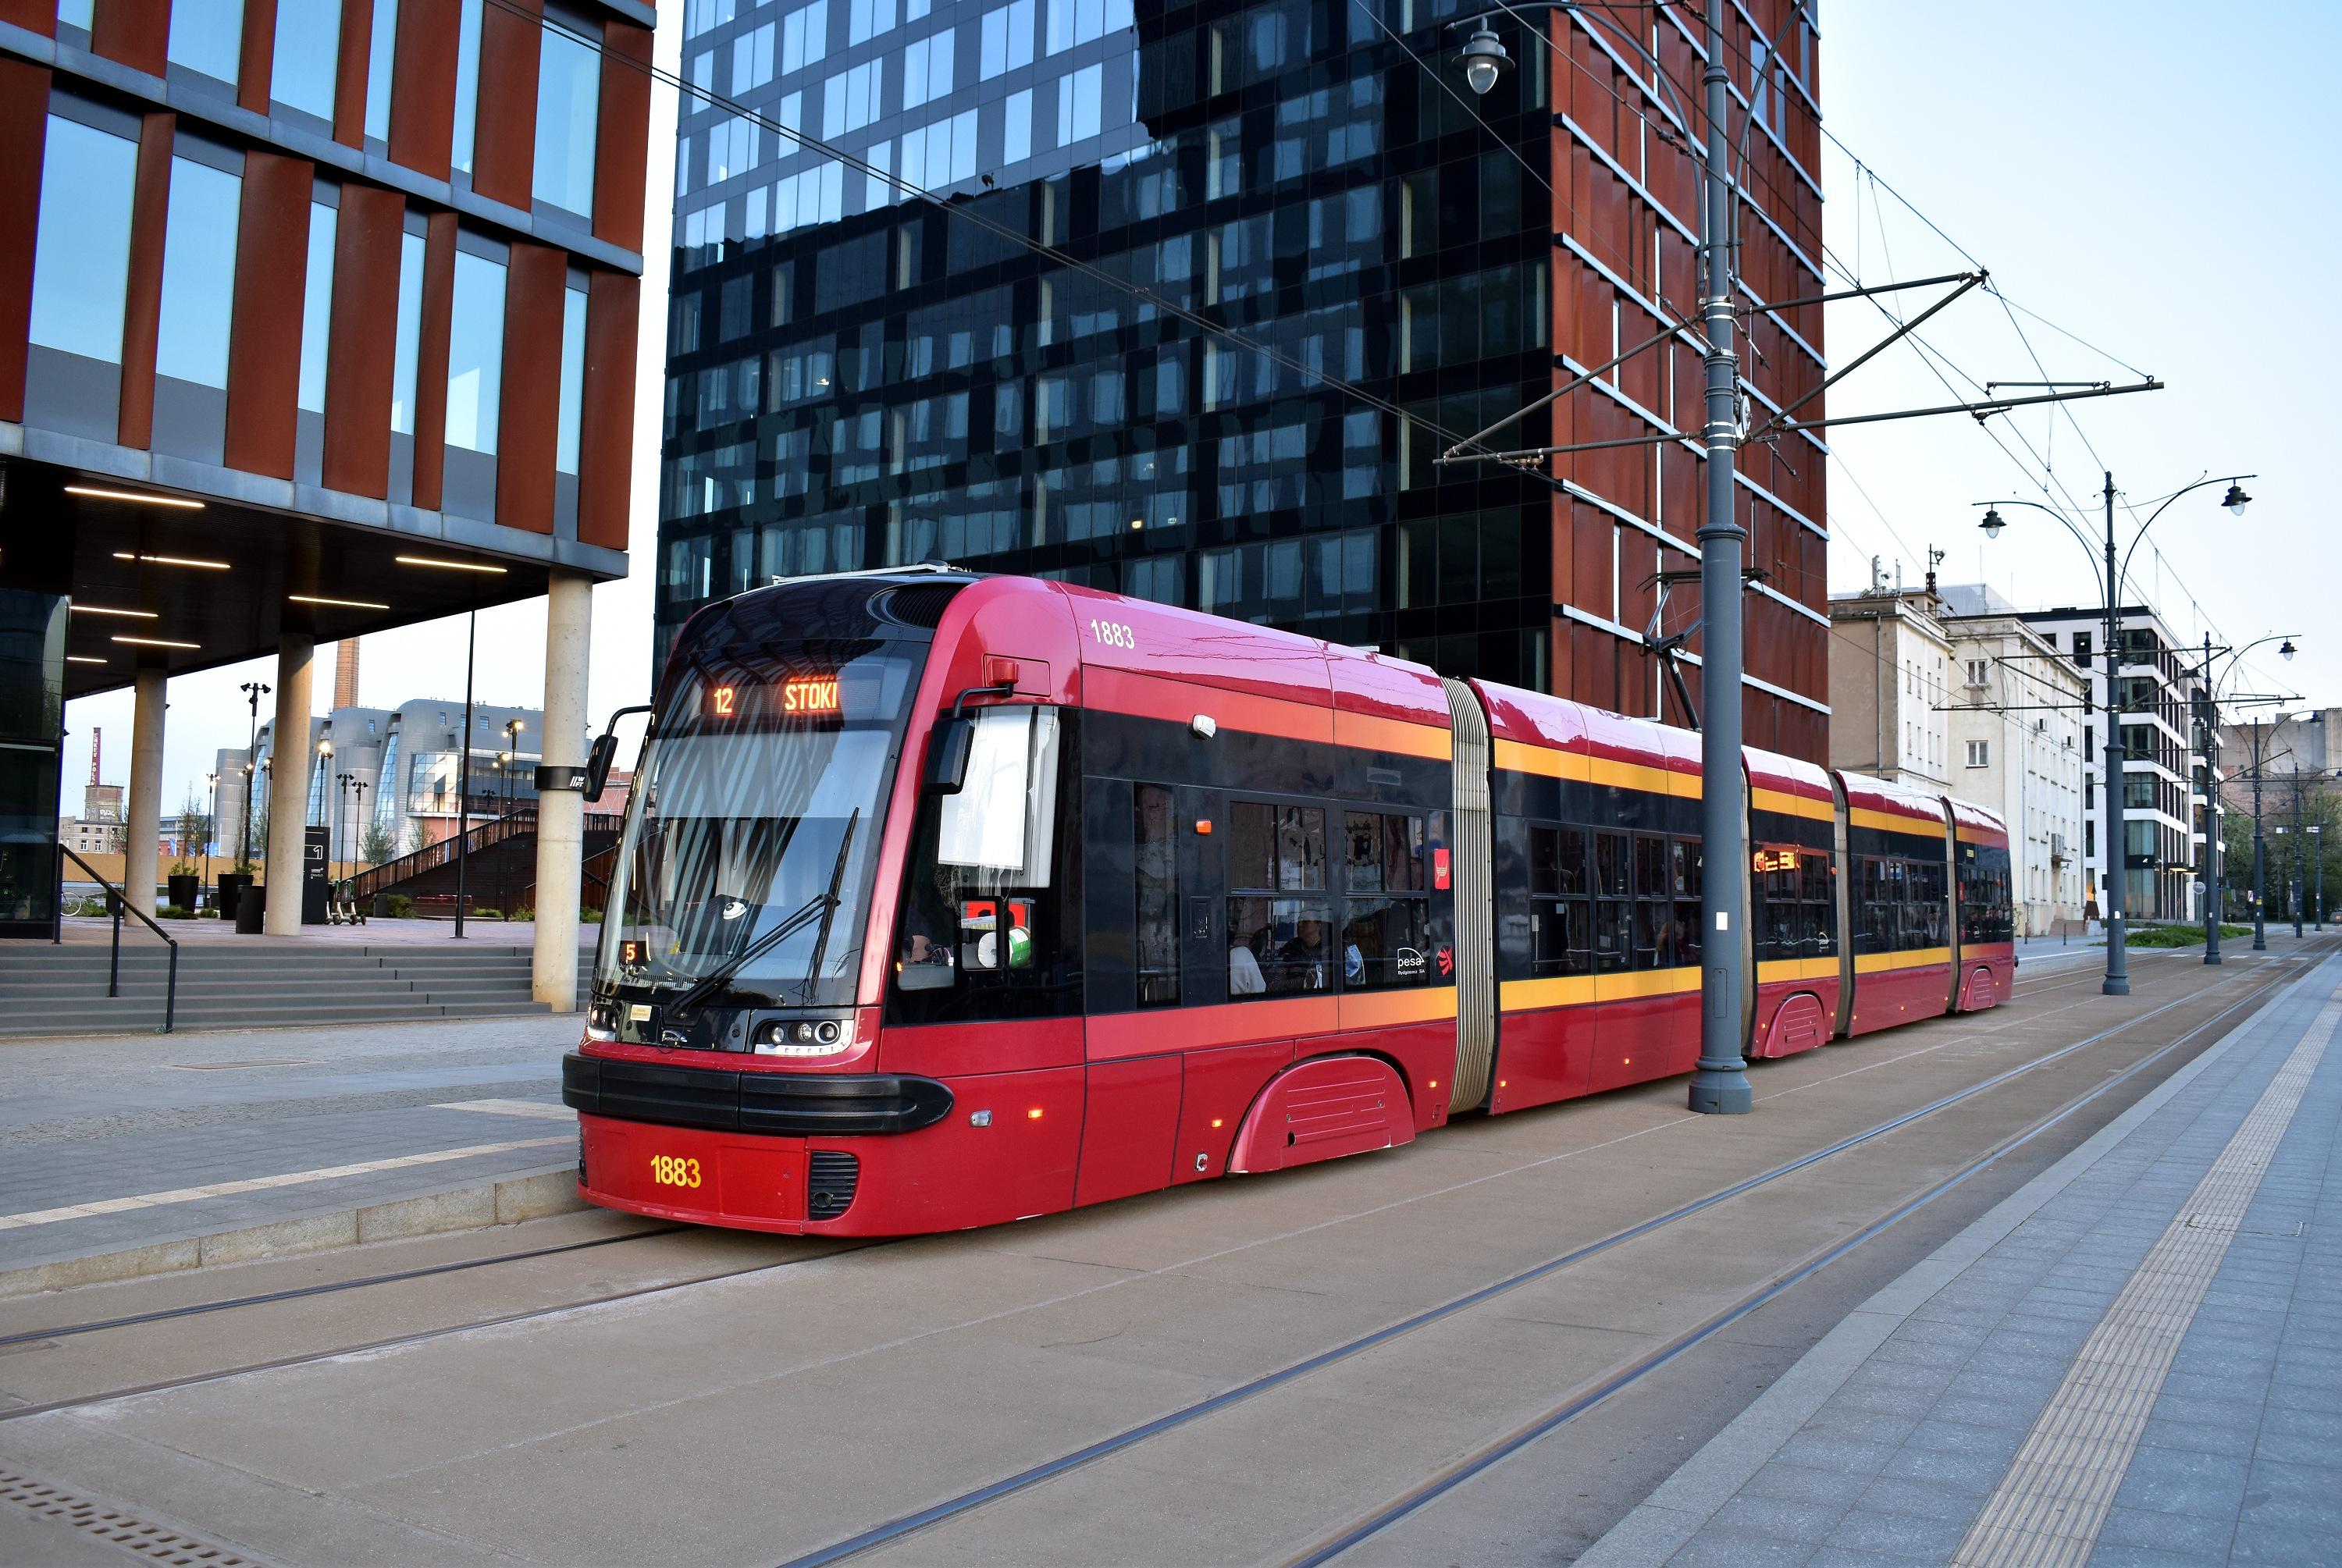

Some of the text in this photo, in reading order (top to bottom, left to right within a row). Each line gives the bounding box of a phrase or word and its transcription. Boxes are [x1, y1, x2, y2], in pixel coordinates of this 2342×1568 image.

[1091, 619, 1135, 649] 1883
[714, 682, 838, 713] 12 STOKI
[313, 845, 323, 859] 1
[626, 944, 635, 961] 5
[1397, 958, 1422, 969] pesa
[650, 1154, 702, 1189] 1883
